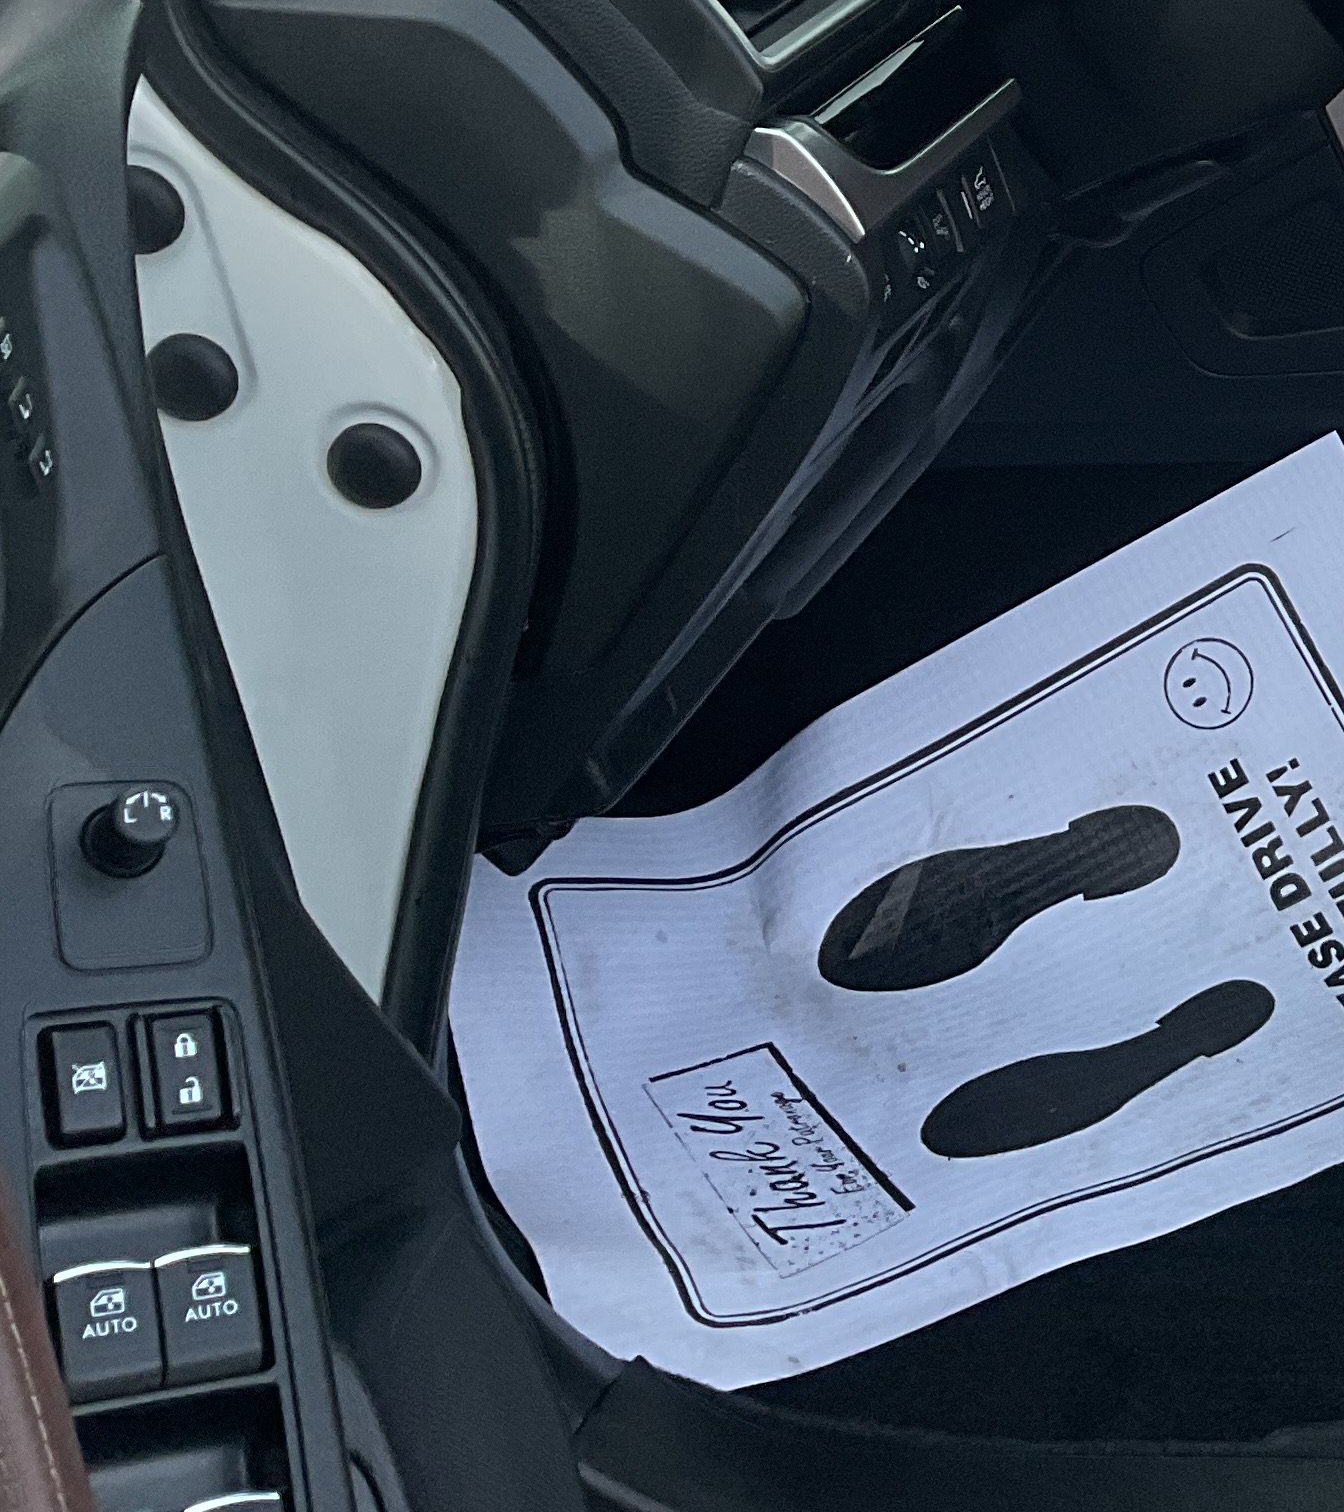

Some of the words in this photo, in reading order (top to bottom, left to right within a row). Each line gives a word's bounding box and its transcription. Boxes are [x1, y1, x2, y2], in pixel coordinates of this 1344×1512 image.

[124, 808, 137, 823] L
[160, 806, 171, 821] R
[1208, 758, 1312, 911] DRIVE
[676, 1080, 765, 1134] You
[709, 1141, 846, 1245] Thank
[82, 1316, 137, 1339] AUTO
[185, 1299, 239, 1323] AUTO
